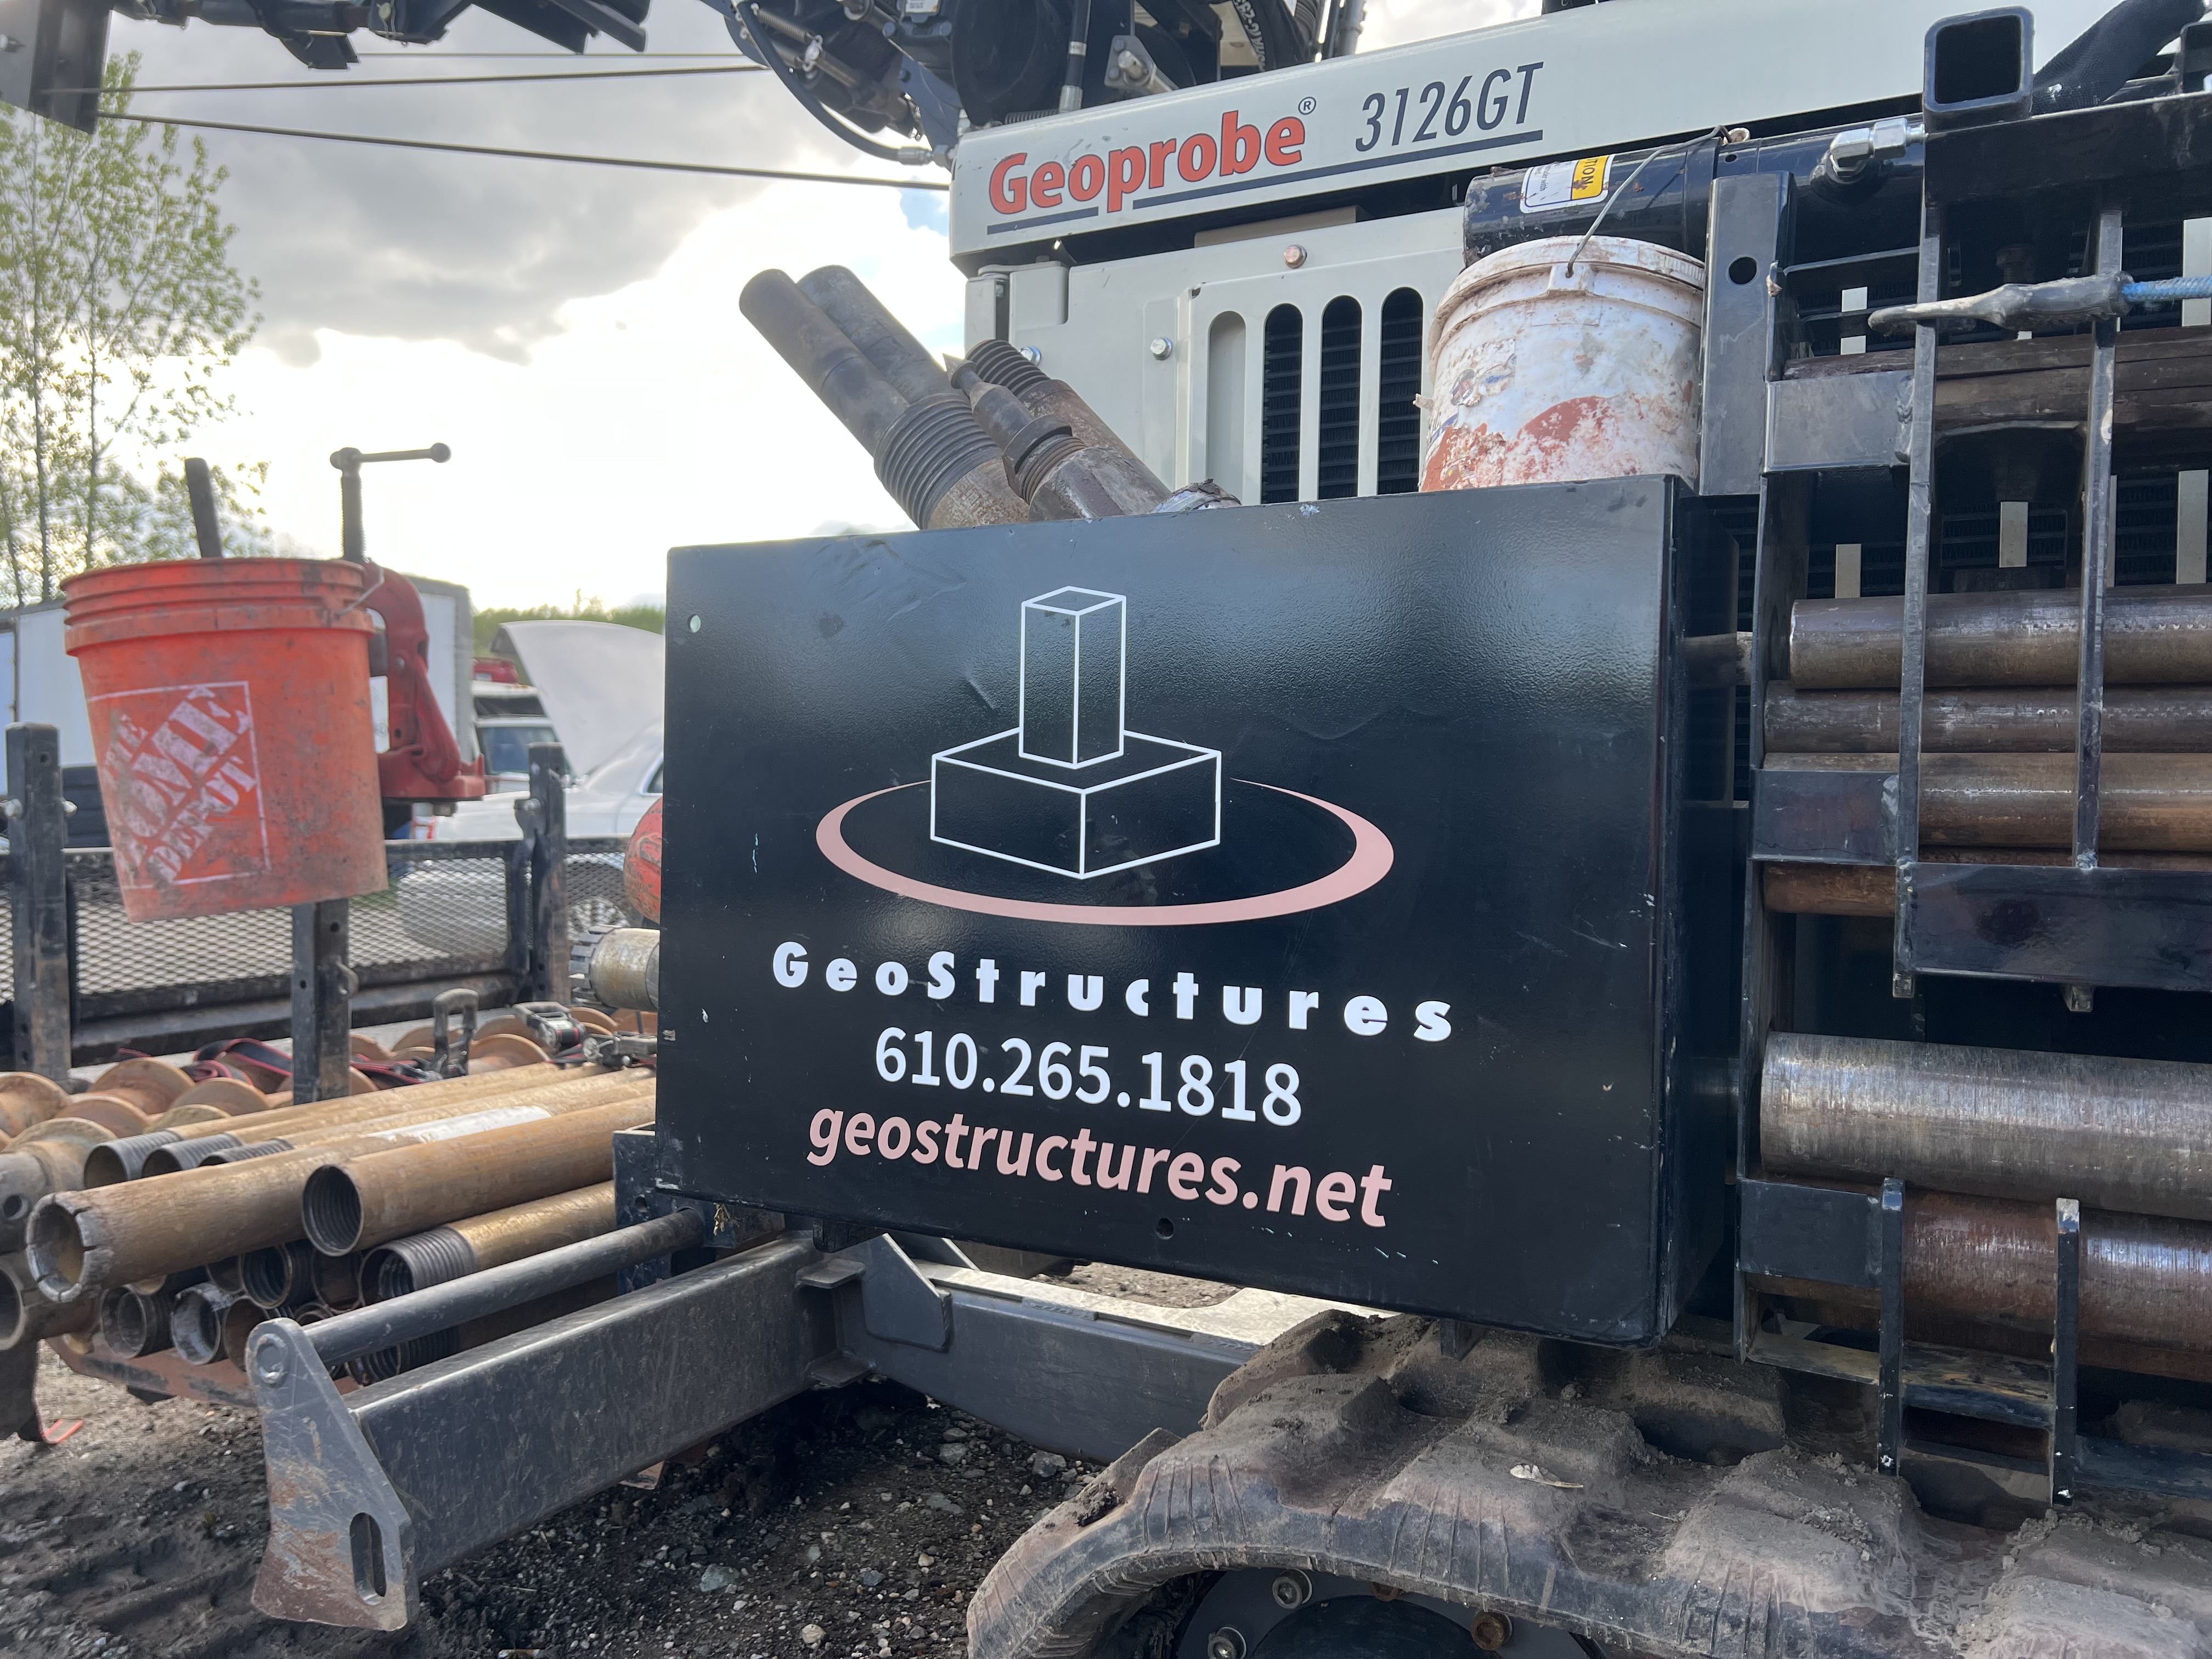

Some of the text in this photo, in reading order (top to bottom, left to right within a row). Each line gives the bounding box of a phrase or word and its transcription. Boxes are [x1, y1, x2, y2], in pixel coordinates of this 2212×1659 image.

[1356, 61, 1543, 152] 3126GT
[772, 941, 1452, 1042] GeoStructures
[876, 1027, 1302, 1126] 610.265.1818
[807, 1107, 1393, 1228] geostructures.net
